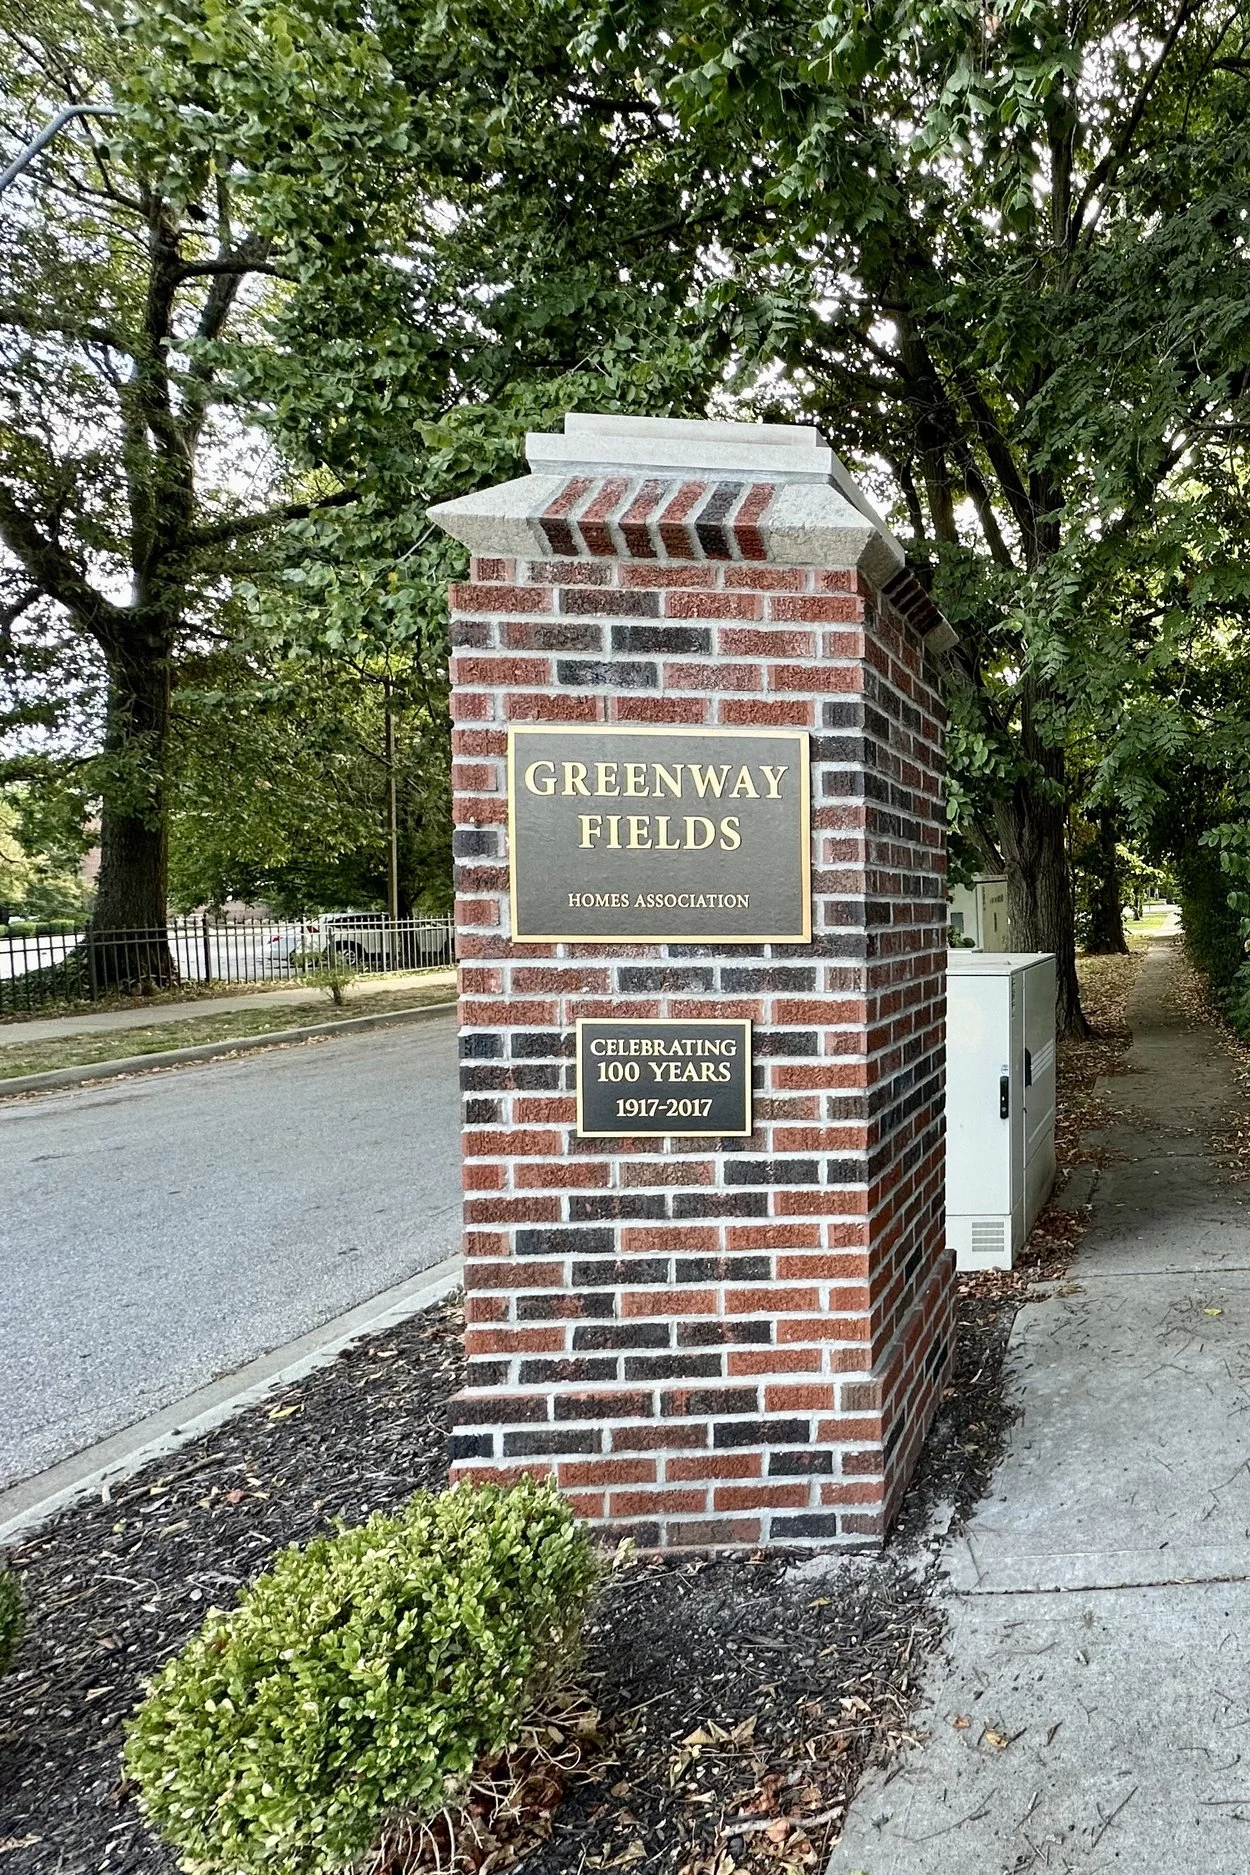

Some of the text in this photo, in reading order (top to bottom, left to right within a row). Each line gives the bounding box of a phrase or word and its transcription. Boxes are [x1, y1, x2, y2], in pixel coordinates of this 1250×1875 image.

[524, 760, 789, 799] GREENWAY
[577, 814, 742, 851] FIELDS
[568, 893, 750, 909] HOMES ASSOCIATION
[590, 1039, 737, 1056] CELEBRATING
[597, 1061, 731, 1082] 100 YEARS
[616, 1098, 713, 1117] 1917-2017
